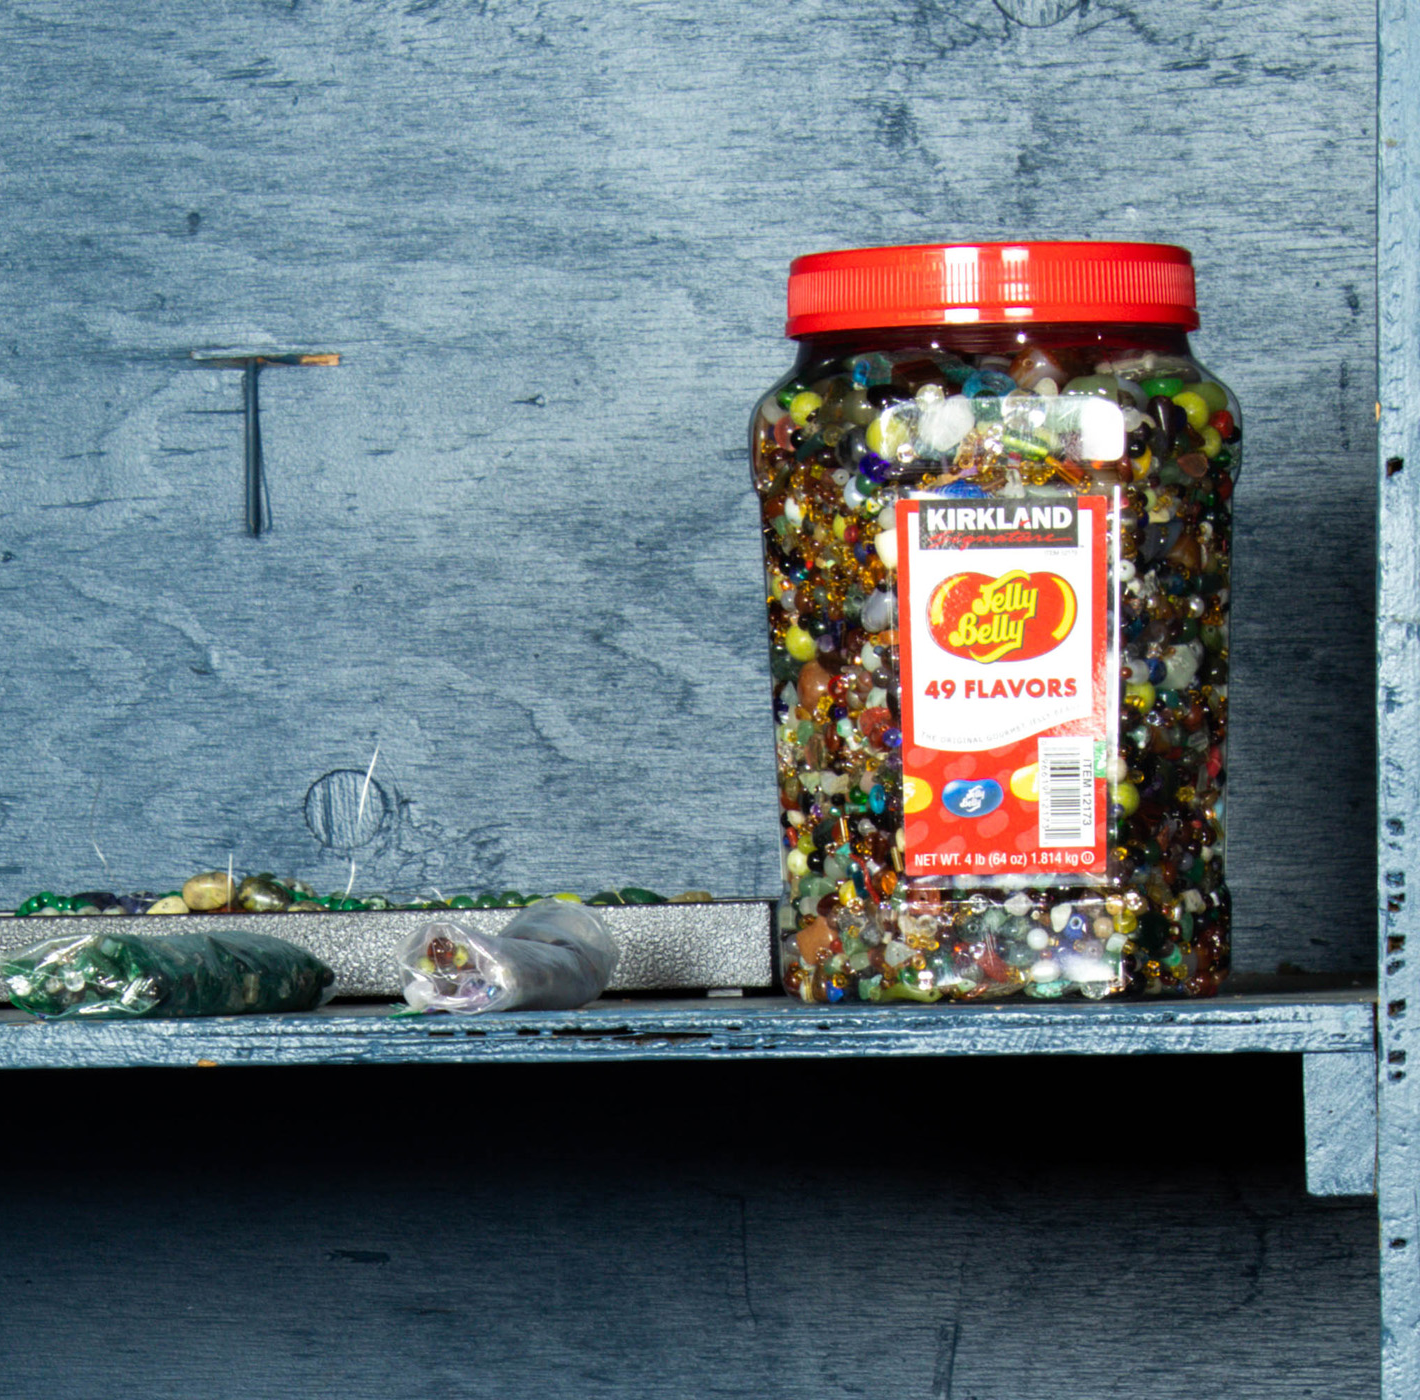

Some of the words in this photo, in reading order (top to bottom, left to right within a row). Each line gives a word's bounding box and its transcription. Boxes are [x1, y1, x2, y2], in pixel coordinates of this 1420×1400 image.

[926, 506, 1073, 531] KIRKLAND
[926, 530, 1073, 551] Signature
[972, 569, 1038, 620] Jelly
[948, 612, 1026, 664] Belly
[924, 680, 956, 700] 49
[964, 678, 1078, 698] FLAVORS
[1083, 759, 1092, 788] ITEM
[1083, 792, 1092, 826] 12173
[914, 854, 936, 866] NET
[940, 854, 961, 866] WT.
[964, 853, 972, 865] 4
[975, 853, 985, 866] lb
[988, 853, 1007, 868] (64
[1010, 852, 1027, 866] oz)
[1031, 852, 1061, 865] 1.814
[1065, 852, 1079, 866] kg
